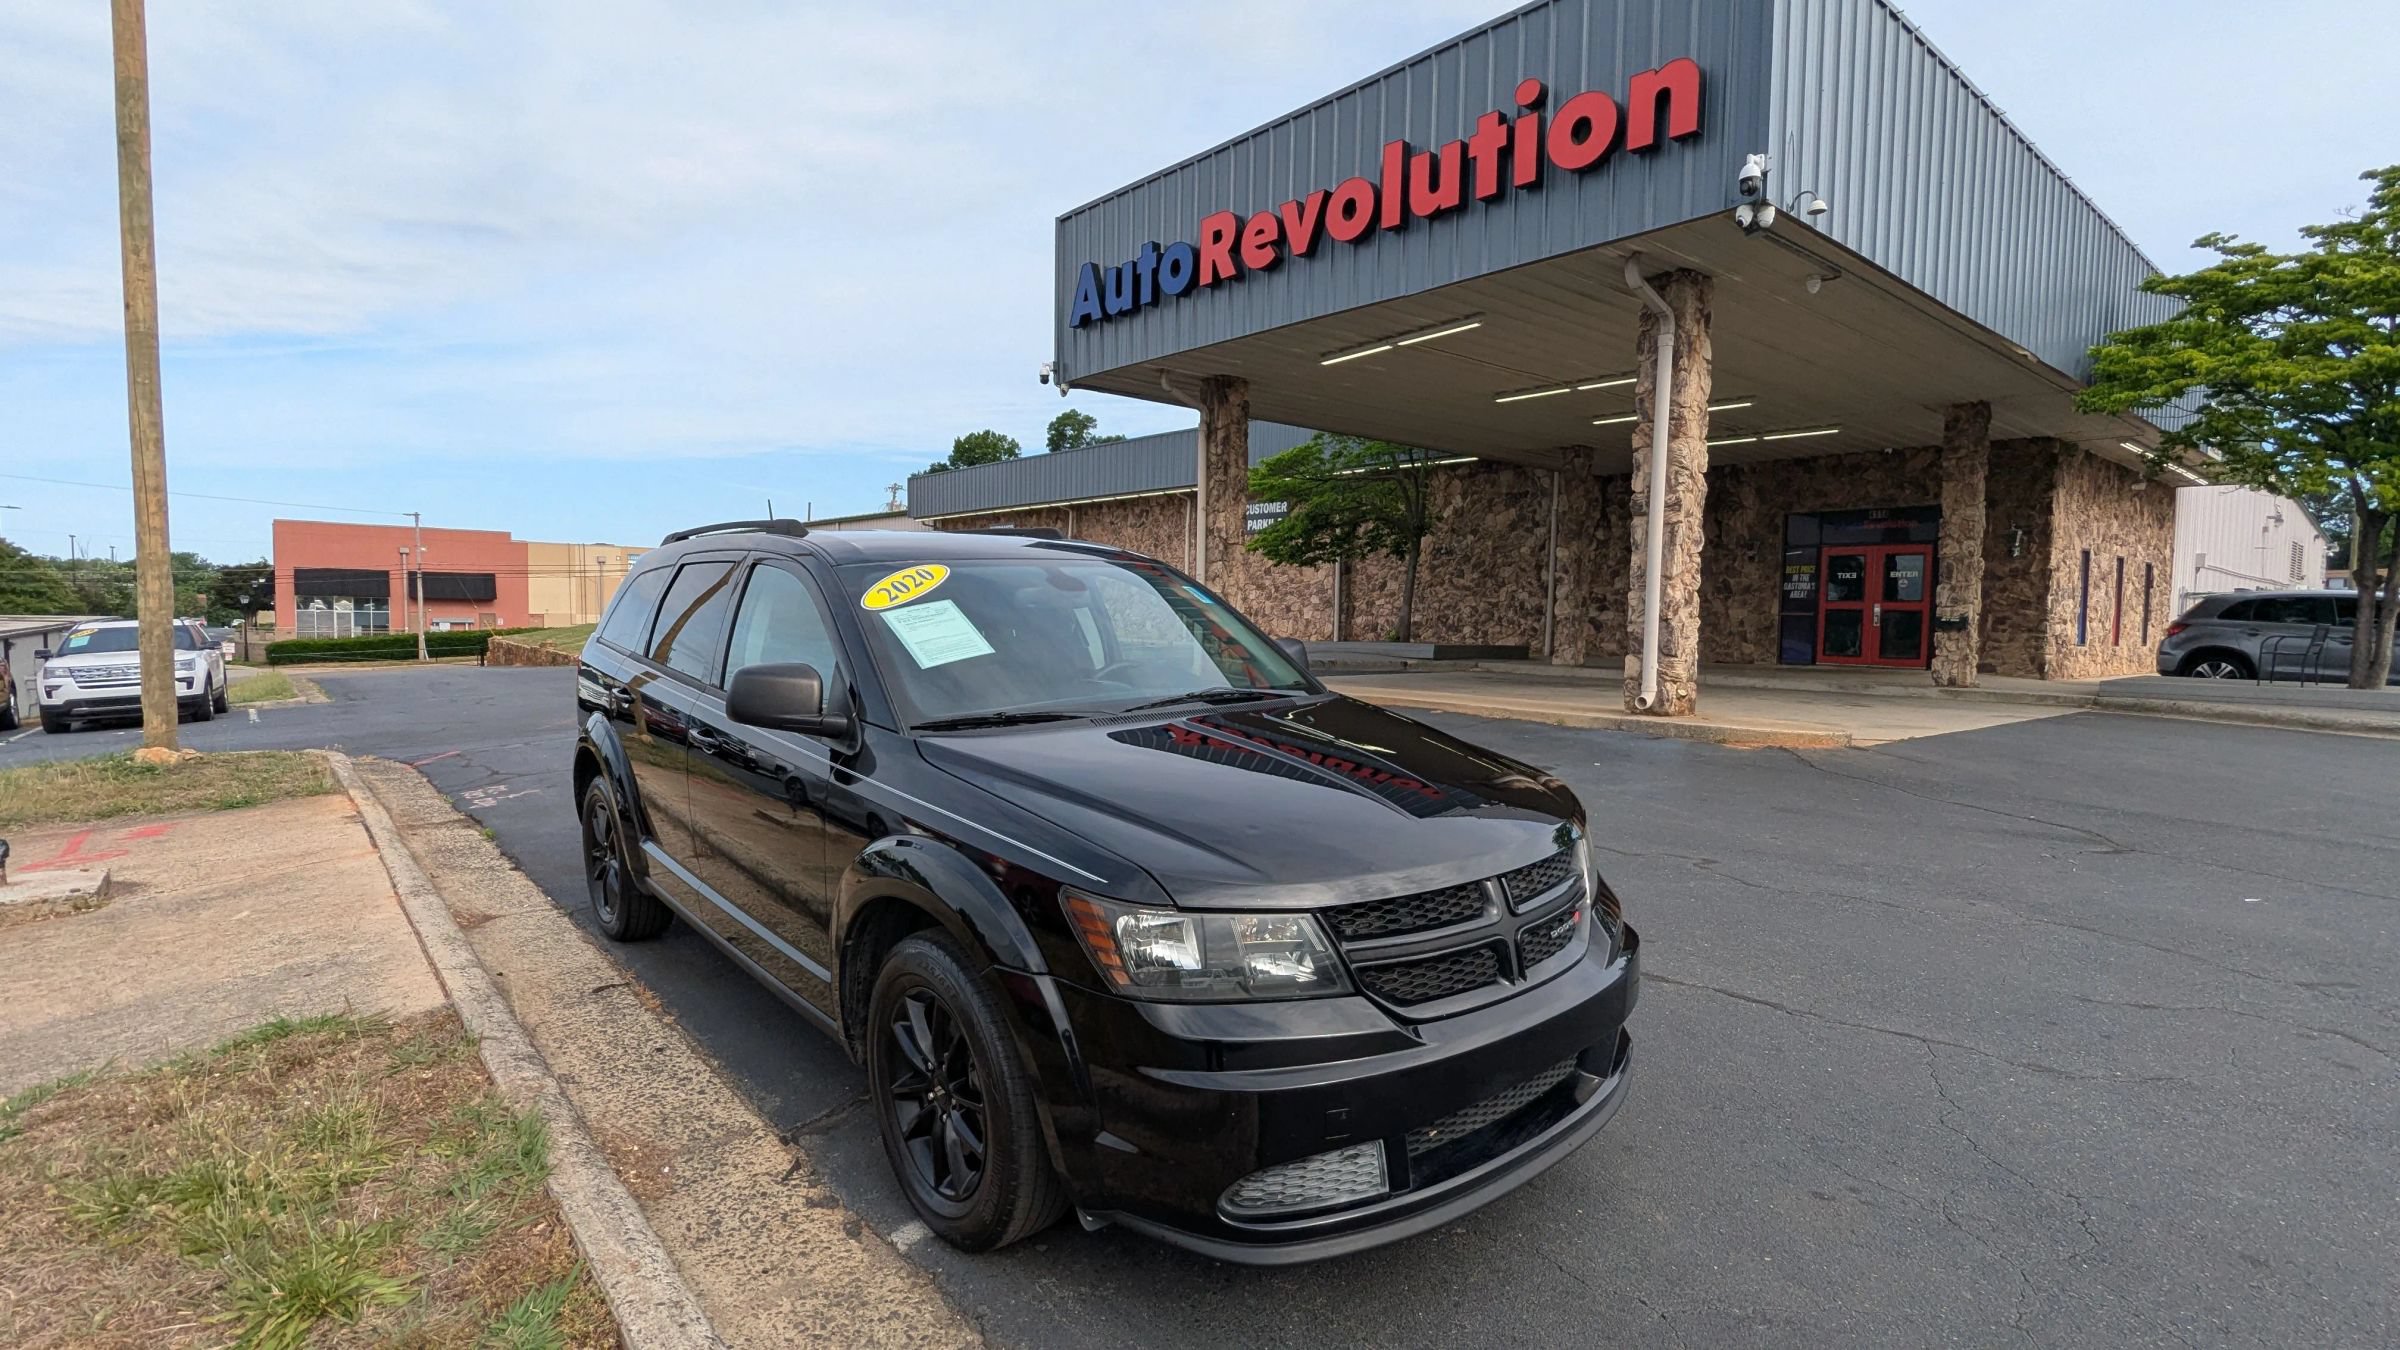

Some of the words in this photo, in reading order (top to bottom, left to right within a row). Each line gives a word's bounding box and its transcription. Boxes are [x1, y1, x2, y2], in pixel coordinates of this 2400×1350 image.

[1069, 57, 1704, 330] AutoRevolution
[1247, 518, 1282, 531] PARK
[877, 568, 935, 603] 2020
